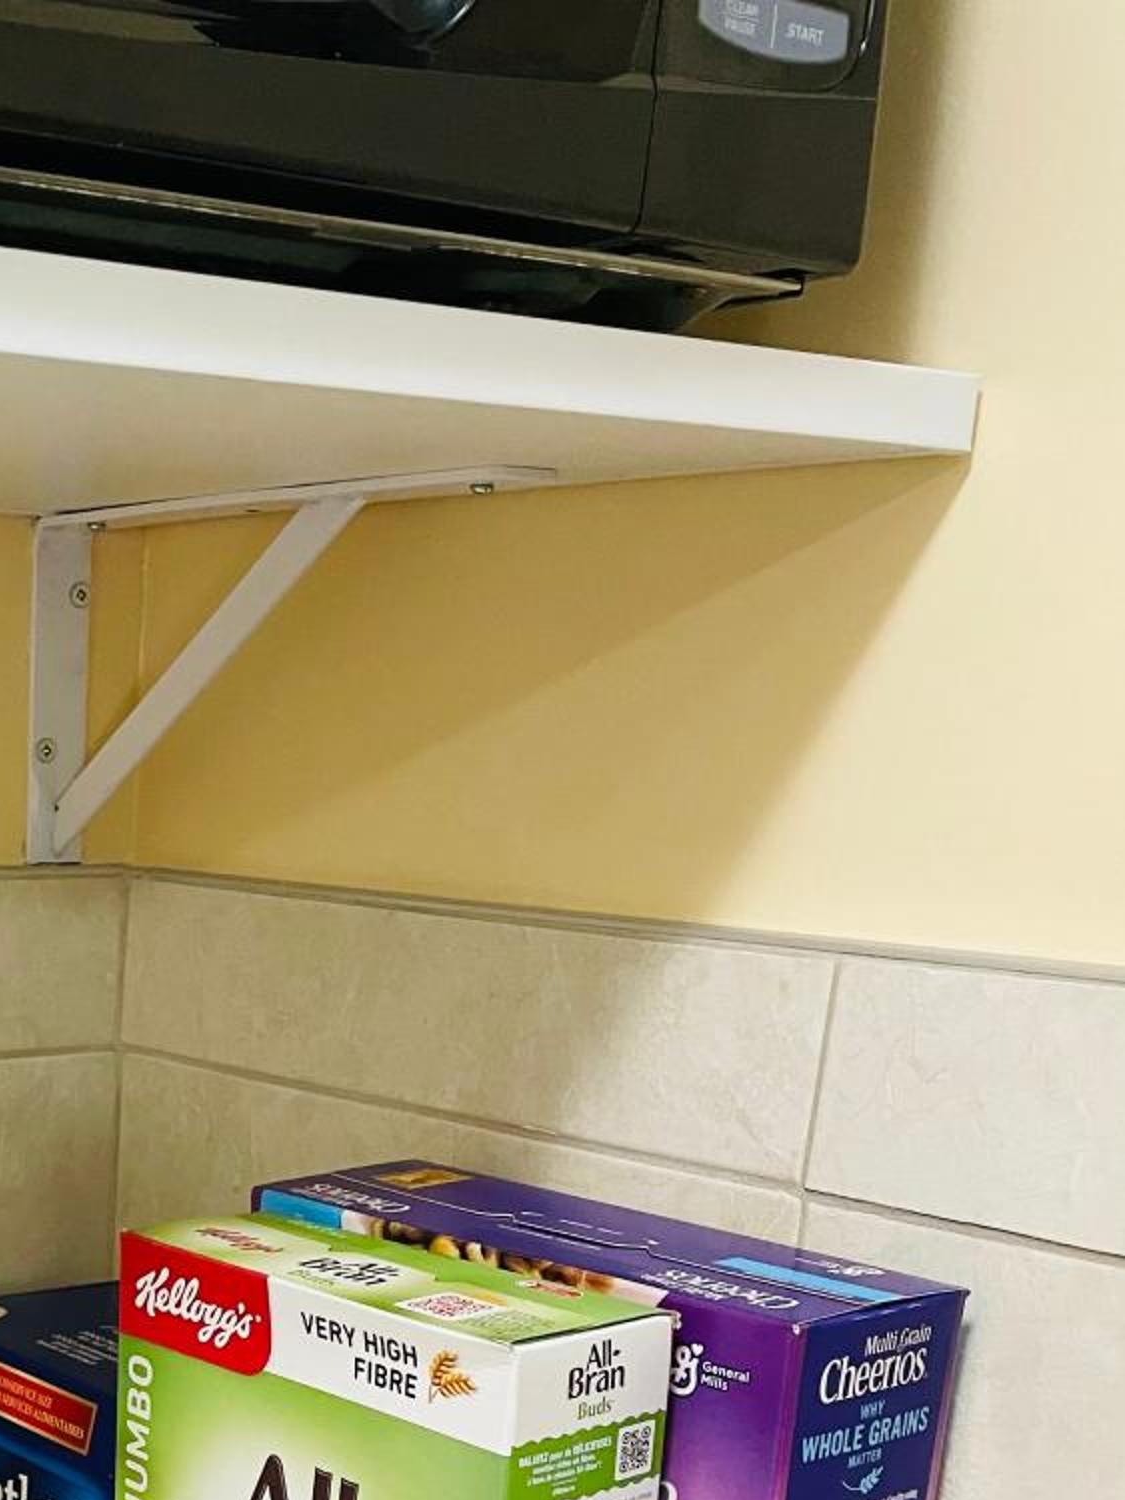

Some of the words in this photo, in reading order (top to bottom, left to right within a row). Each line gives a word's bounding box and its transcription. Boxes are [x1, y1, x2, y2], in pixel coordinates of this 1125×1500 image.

[785, 22, 826, 46] START
[134, 1266, 254, 1349] Kellogg's
[299, 1310, 356, 1348] VERY
[363, 1330, 419, 1369] HIGH
[353, 1357, 418, 1400] FIBRE
[568, 1363, 625, 1400] Bran
[700, 1373, 728, 1391] Mills
[702, 1361, 751, 1384] General
[818, 1347, 928, 1405] Cheerios
[577, 1395, 613, 1421] Buds
[801, 1424, 865, 1464] WHOLE
[868, 1406, 930, 1446] GRAINS
